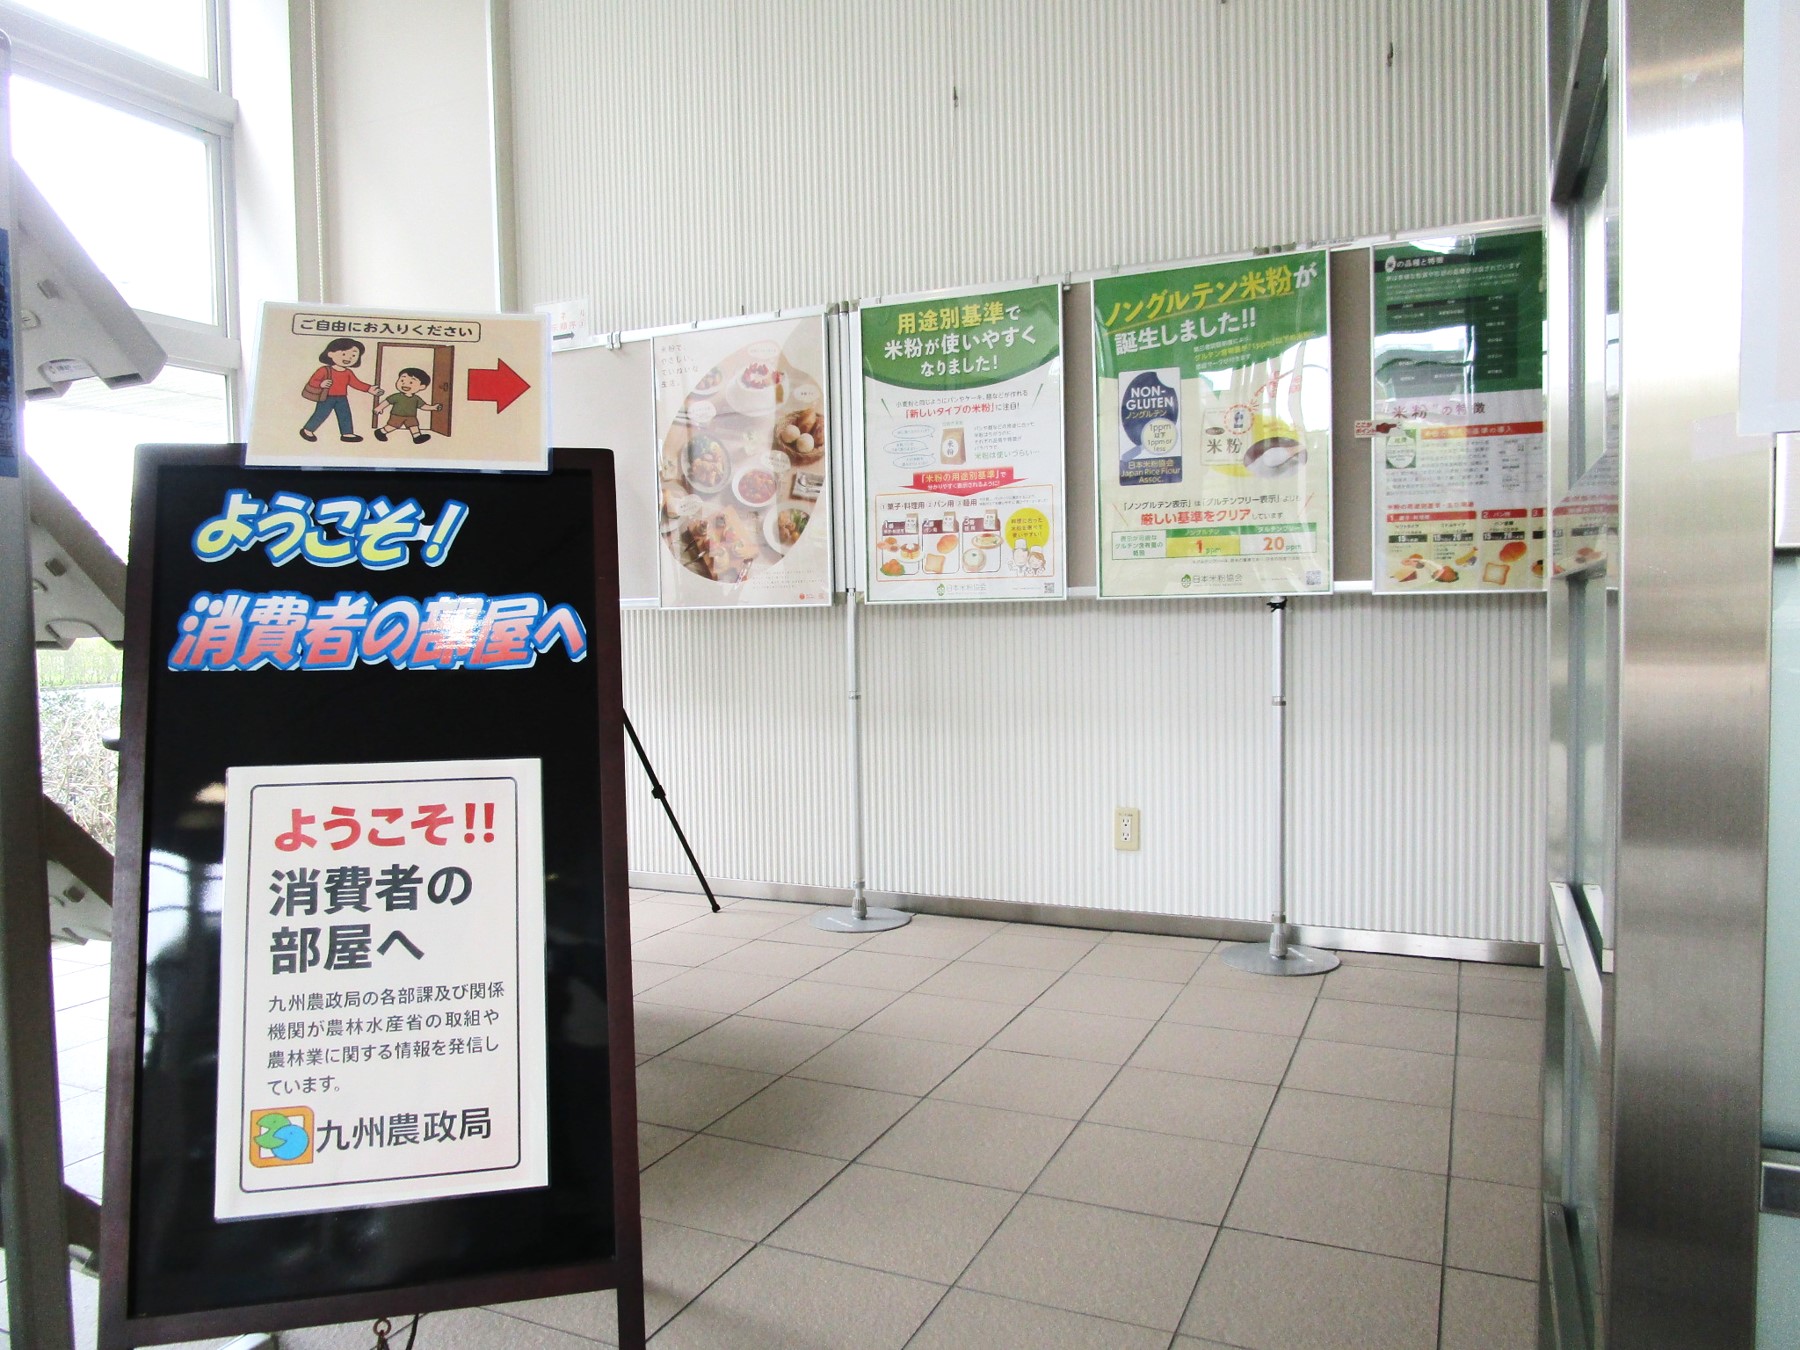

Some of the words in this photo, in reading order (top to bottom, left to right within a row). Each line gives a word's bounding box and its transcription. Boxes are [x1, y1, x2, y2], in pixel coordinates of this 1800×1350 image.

[1104, 261, 1318, 328] ノングルテン米粉が
[299, 318, 474, 338] ご自由にお入りください
[897, 301, 1021, 335] 用途別基準で
[884, 325, 1036, 360] 米粉が使いやすく
[1131, 386, 1166, 398] NON-
[1125, 409, 1168, 420] ノングルテン
[1126, 397, 1174, 411] GLUTEN
[1149, 423, 1172, 434] 1ppm
[1147, 439, 1165, 448] 1ppm
[1207, 438, 1243, 454] 米粉
[1120, 468, 1144, 478] Japan
[1144, 468, 1160, 477] Rice
[1161, 467, 1181, 475] Flour
[1128, 460, 1175, 469] 日本米粉協会
[1139, 476, 1165, 484] Assoc.
[1263, 536, 1285, 551] 20
[168, 589, 588, 671] 消費者の部屋へ
[273, 802, 495, 852] ようこそ!!
[269, 862, 474, 917] 消費者の
[270, 923, 425, 975] 部屋へ
[268, 981, 505, 1014] 九州農政局の各部課及び関係
[267, 1009, 500, 1041] 機関が農林水産省の取組や
[267, 1036, 499, 1069] 農林業に関する情報を発信し
[267, 1075, 341, 1096] ています。
[316, 1107, 492, 1154] 九州農政局
